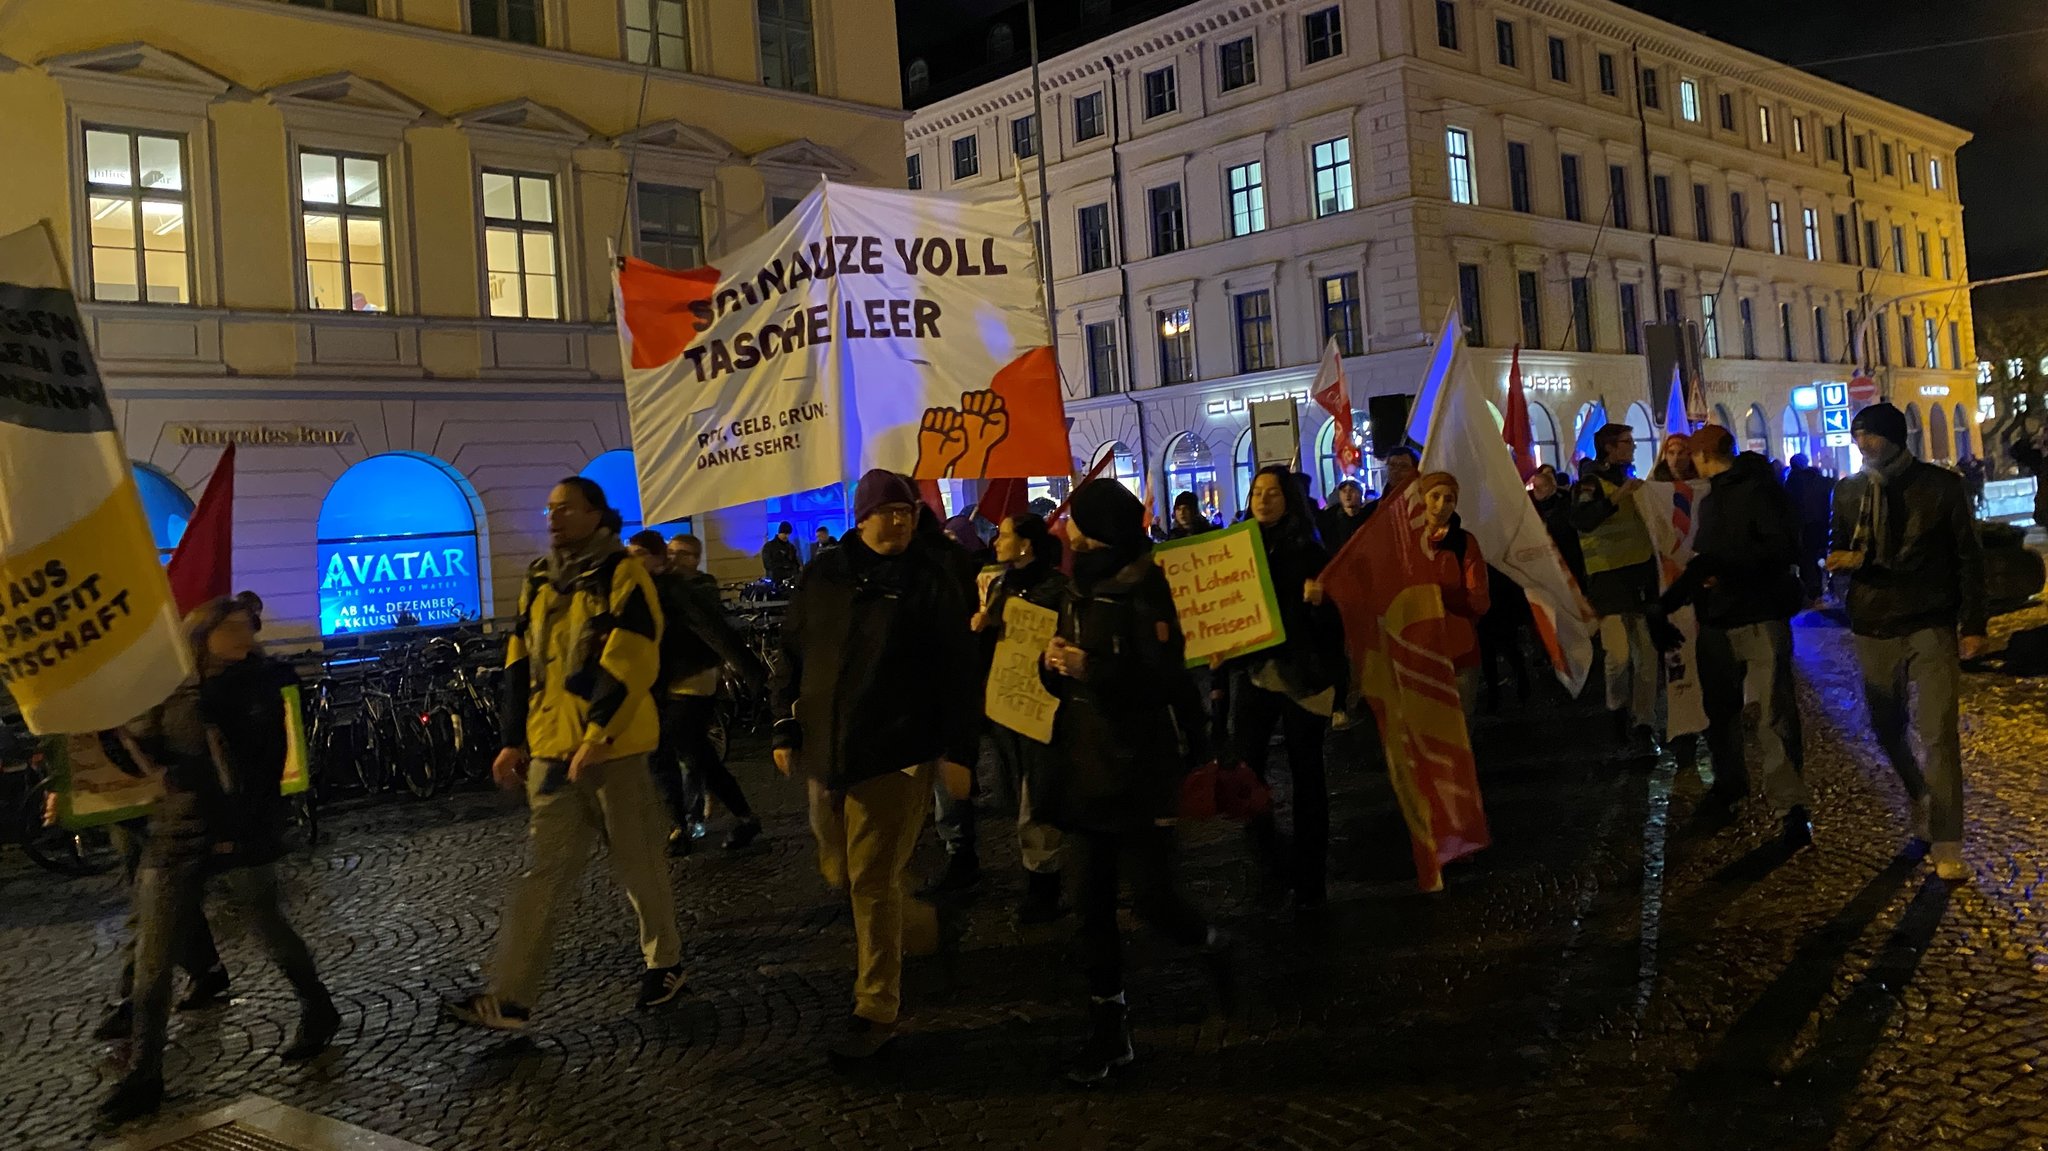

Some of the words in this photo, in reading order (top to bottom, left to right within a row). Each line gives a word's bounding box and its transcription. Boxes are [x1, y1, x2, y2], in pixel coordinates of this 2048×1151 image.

[895, 237, 1008, 276] VOLL
[684, 304, 832, 382] TASCHE
[845, 299, 942, 339] LEER
[1519, 375, 1571, 391] UPRA
[1826, 386, 1843, 405] U
[731, 415, 776, 437] GELB,
[697, 444, 750, 470] DANKE
[754, 433, 800, 457] SEHR!
[1208, 544, 1233, 565] mit
[320, 549, 470, 589] AVATAR
[337, 589, 359, 598] THE
[368, 586, 391, 595] WAY
[399, 584, 413, 593] OF
[421, 580, 457, 590] WATER
[1171, 583, 1191, 599] en
[1219, 590, 1247, 609] mit
[2, 572, 101, 649] PROFIT
[340, 605, 357, 617] AB
[362, 603, 380, 615] 14.
[386, 596, 454, 613] DEZEMBER
[335, 612, 400, 629] EXKLUSIV
[1198, 603, 1262, 639] Preisen!
